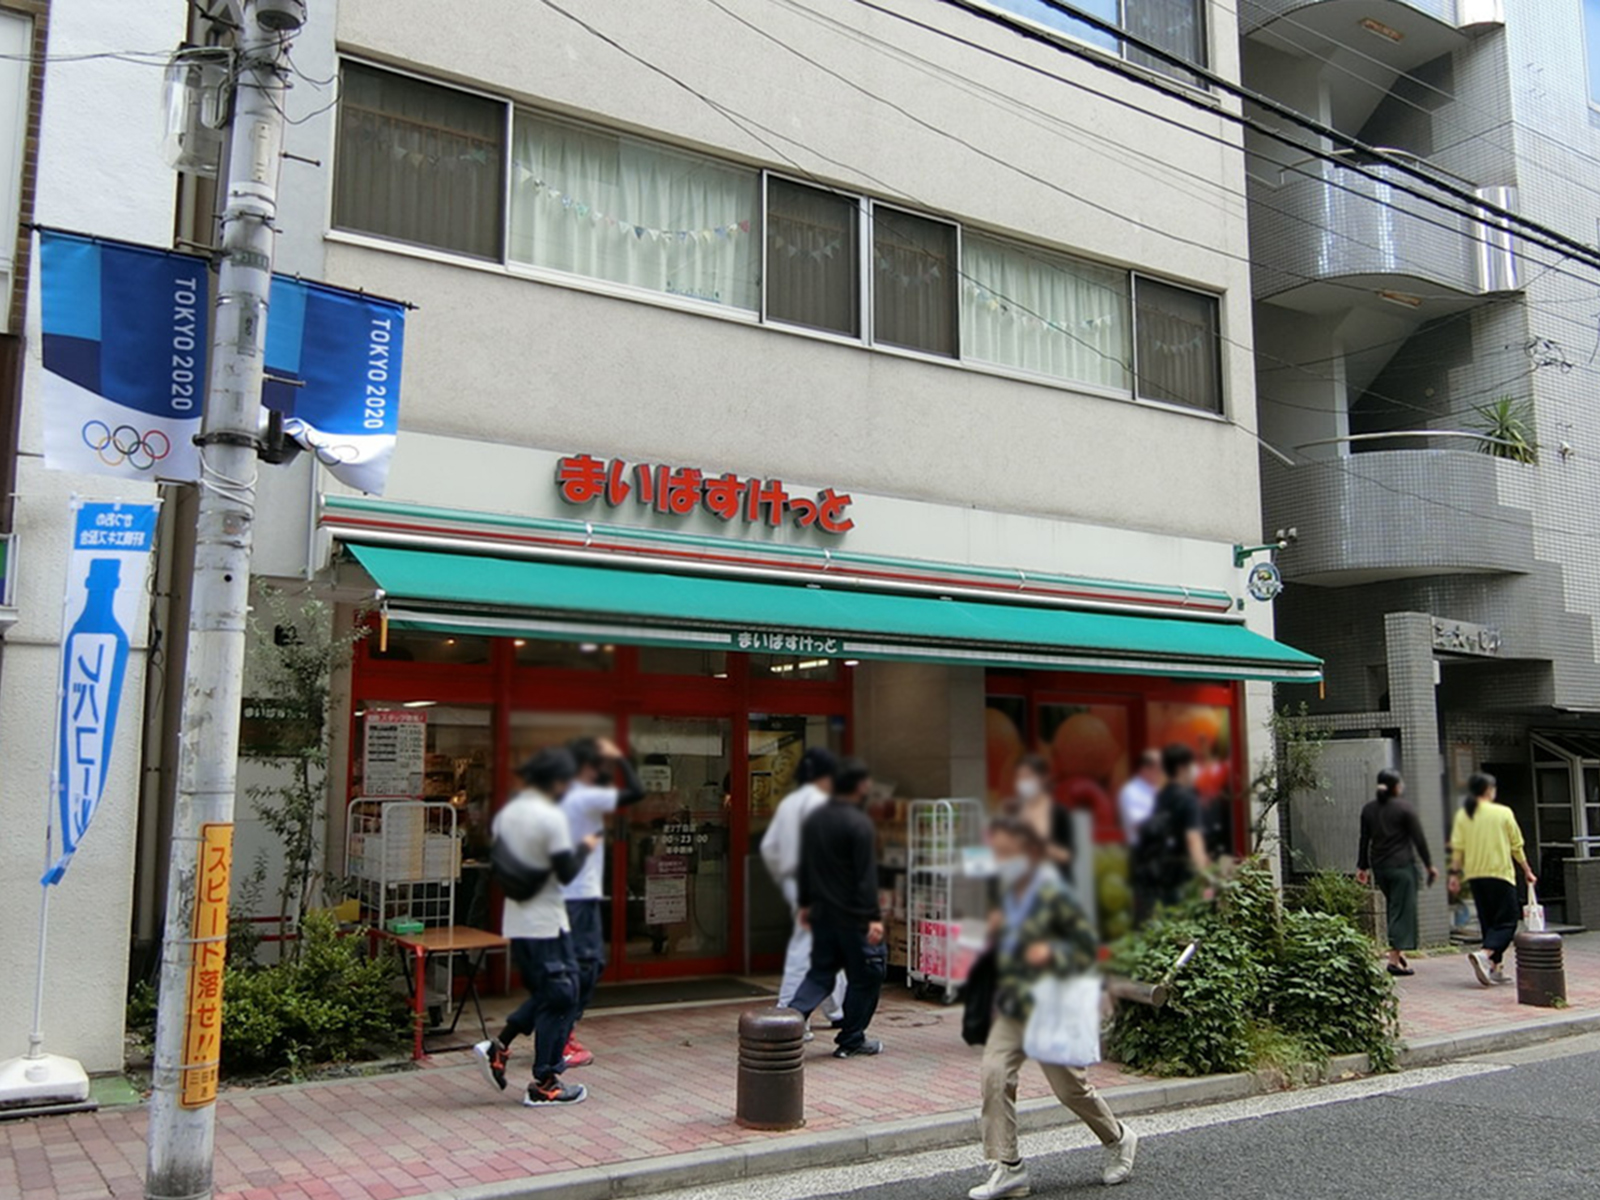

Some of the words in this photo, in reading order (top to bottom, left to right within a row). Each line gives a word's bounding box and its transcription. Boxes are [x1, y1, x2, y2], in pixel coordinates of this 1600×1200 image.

[173, 277, 195, 354] TOKYO
[368, 319, 391, 382] TOKYO
[171, 355, 194, 410] 2020
[364, 386, 387, 429] 2020
[555, 453, 855, 534] まいばすけっと
[738, 631, 837, 653] まいばすけっと
